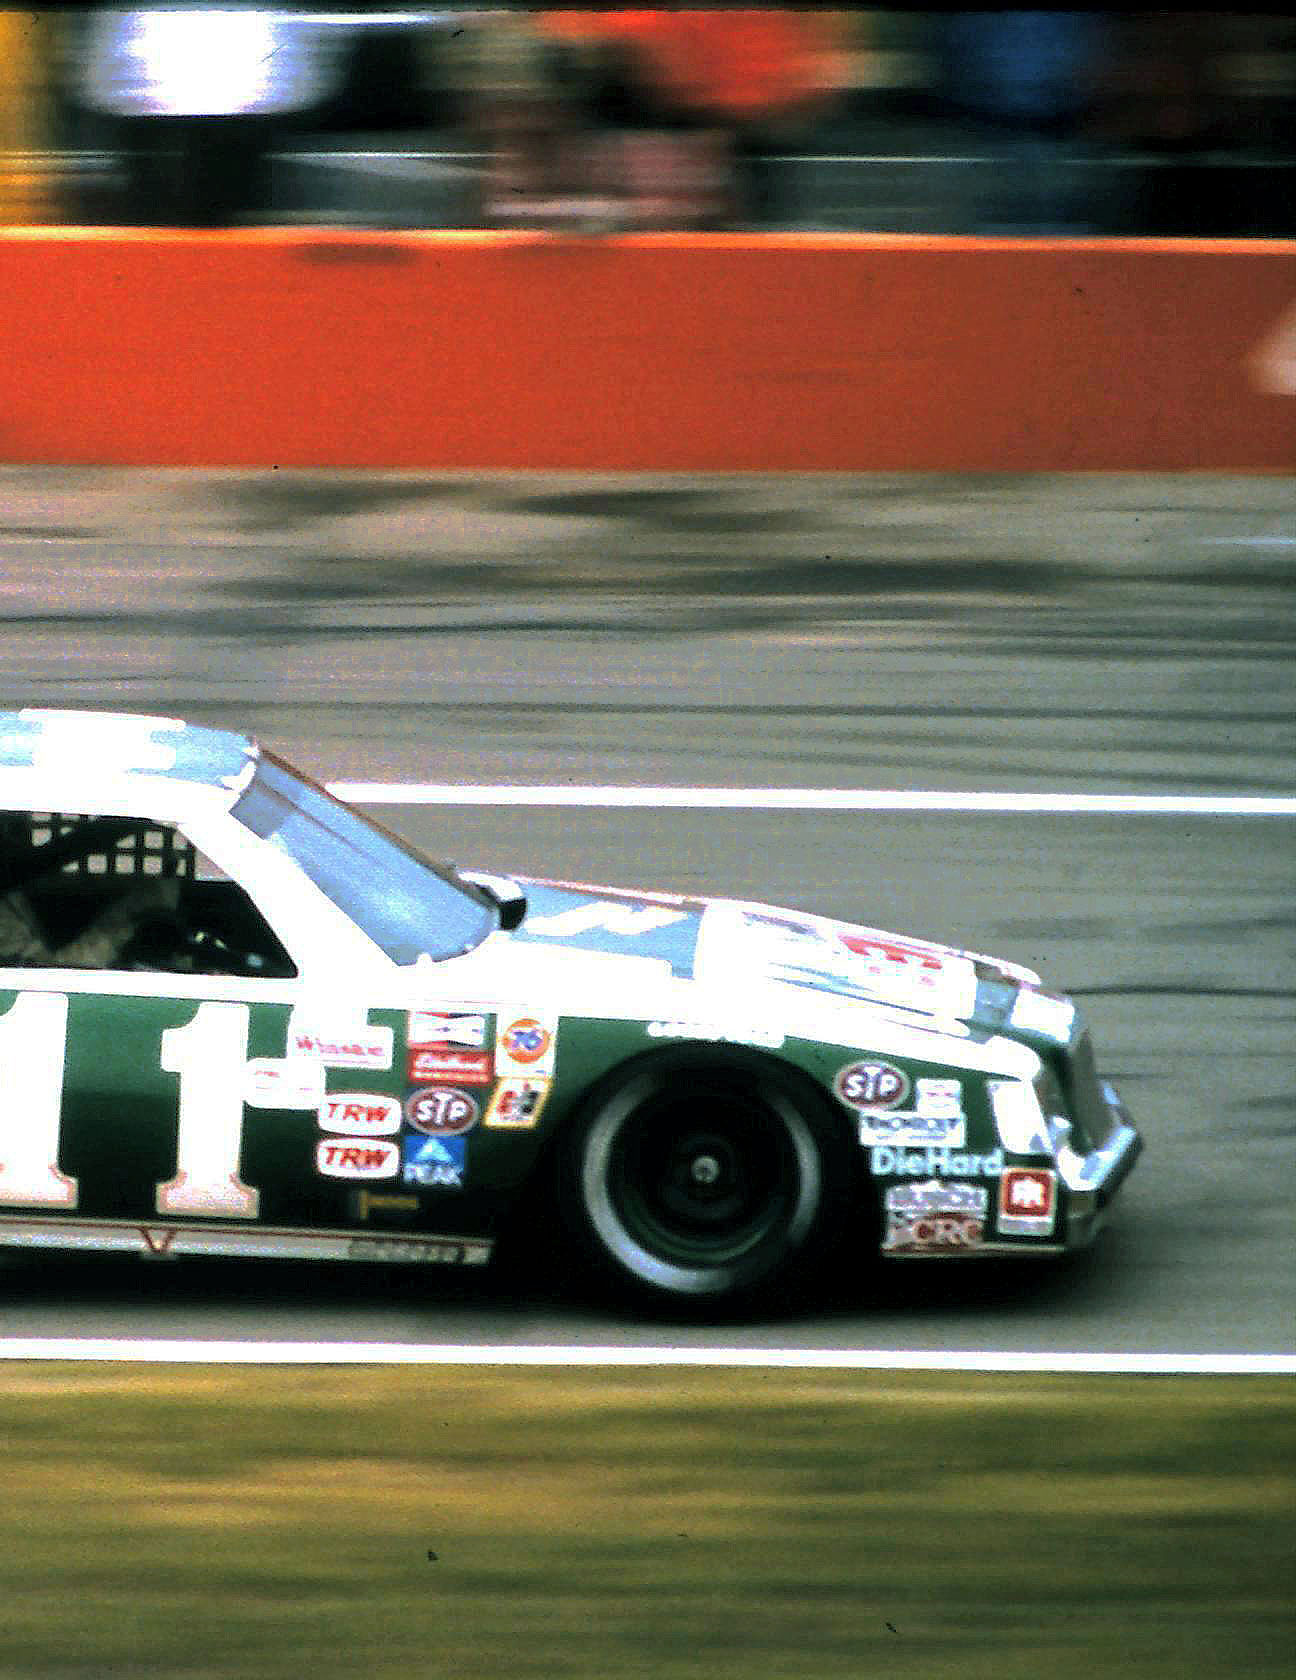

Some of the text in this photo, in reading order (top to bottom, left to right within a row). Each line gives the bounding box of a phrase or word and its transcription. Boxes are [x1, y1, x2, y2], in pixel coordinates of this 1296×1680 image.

[845, 1065, 898, 1100] STP
[328, 1102, 392, 1123] TRW
[415, 1091, 468, 1127] STP
[325, 1146, 391, 1169] TRW
[871, 1146, 1004, 1177] DieHard
